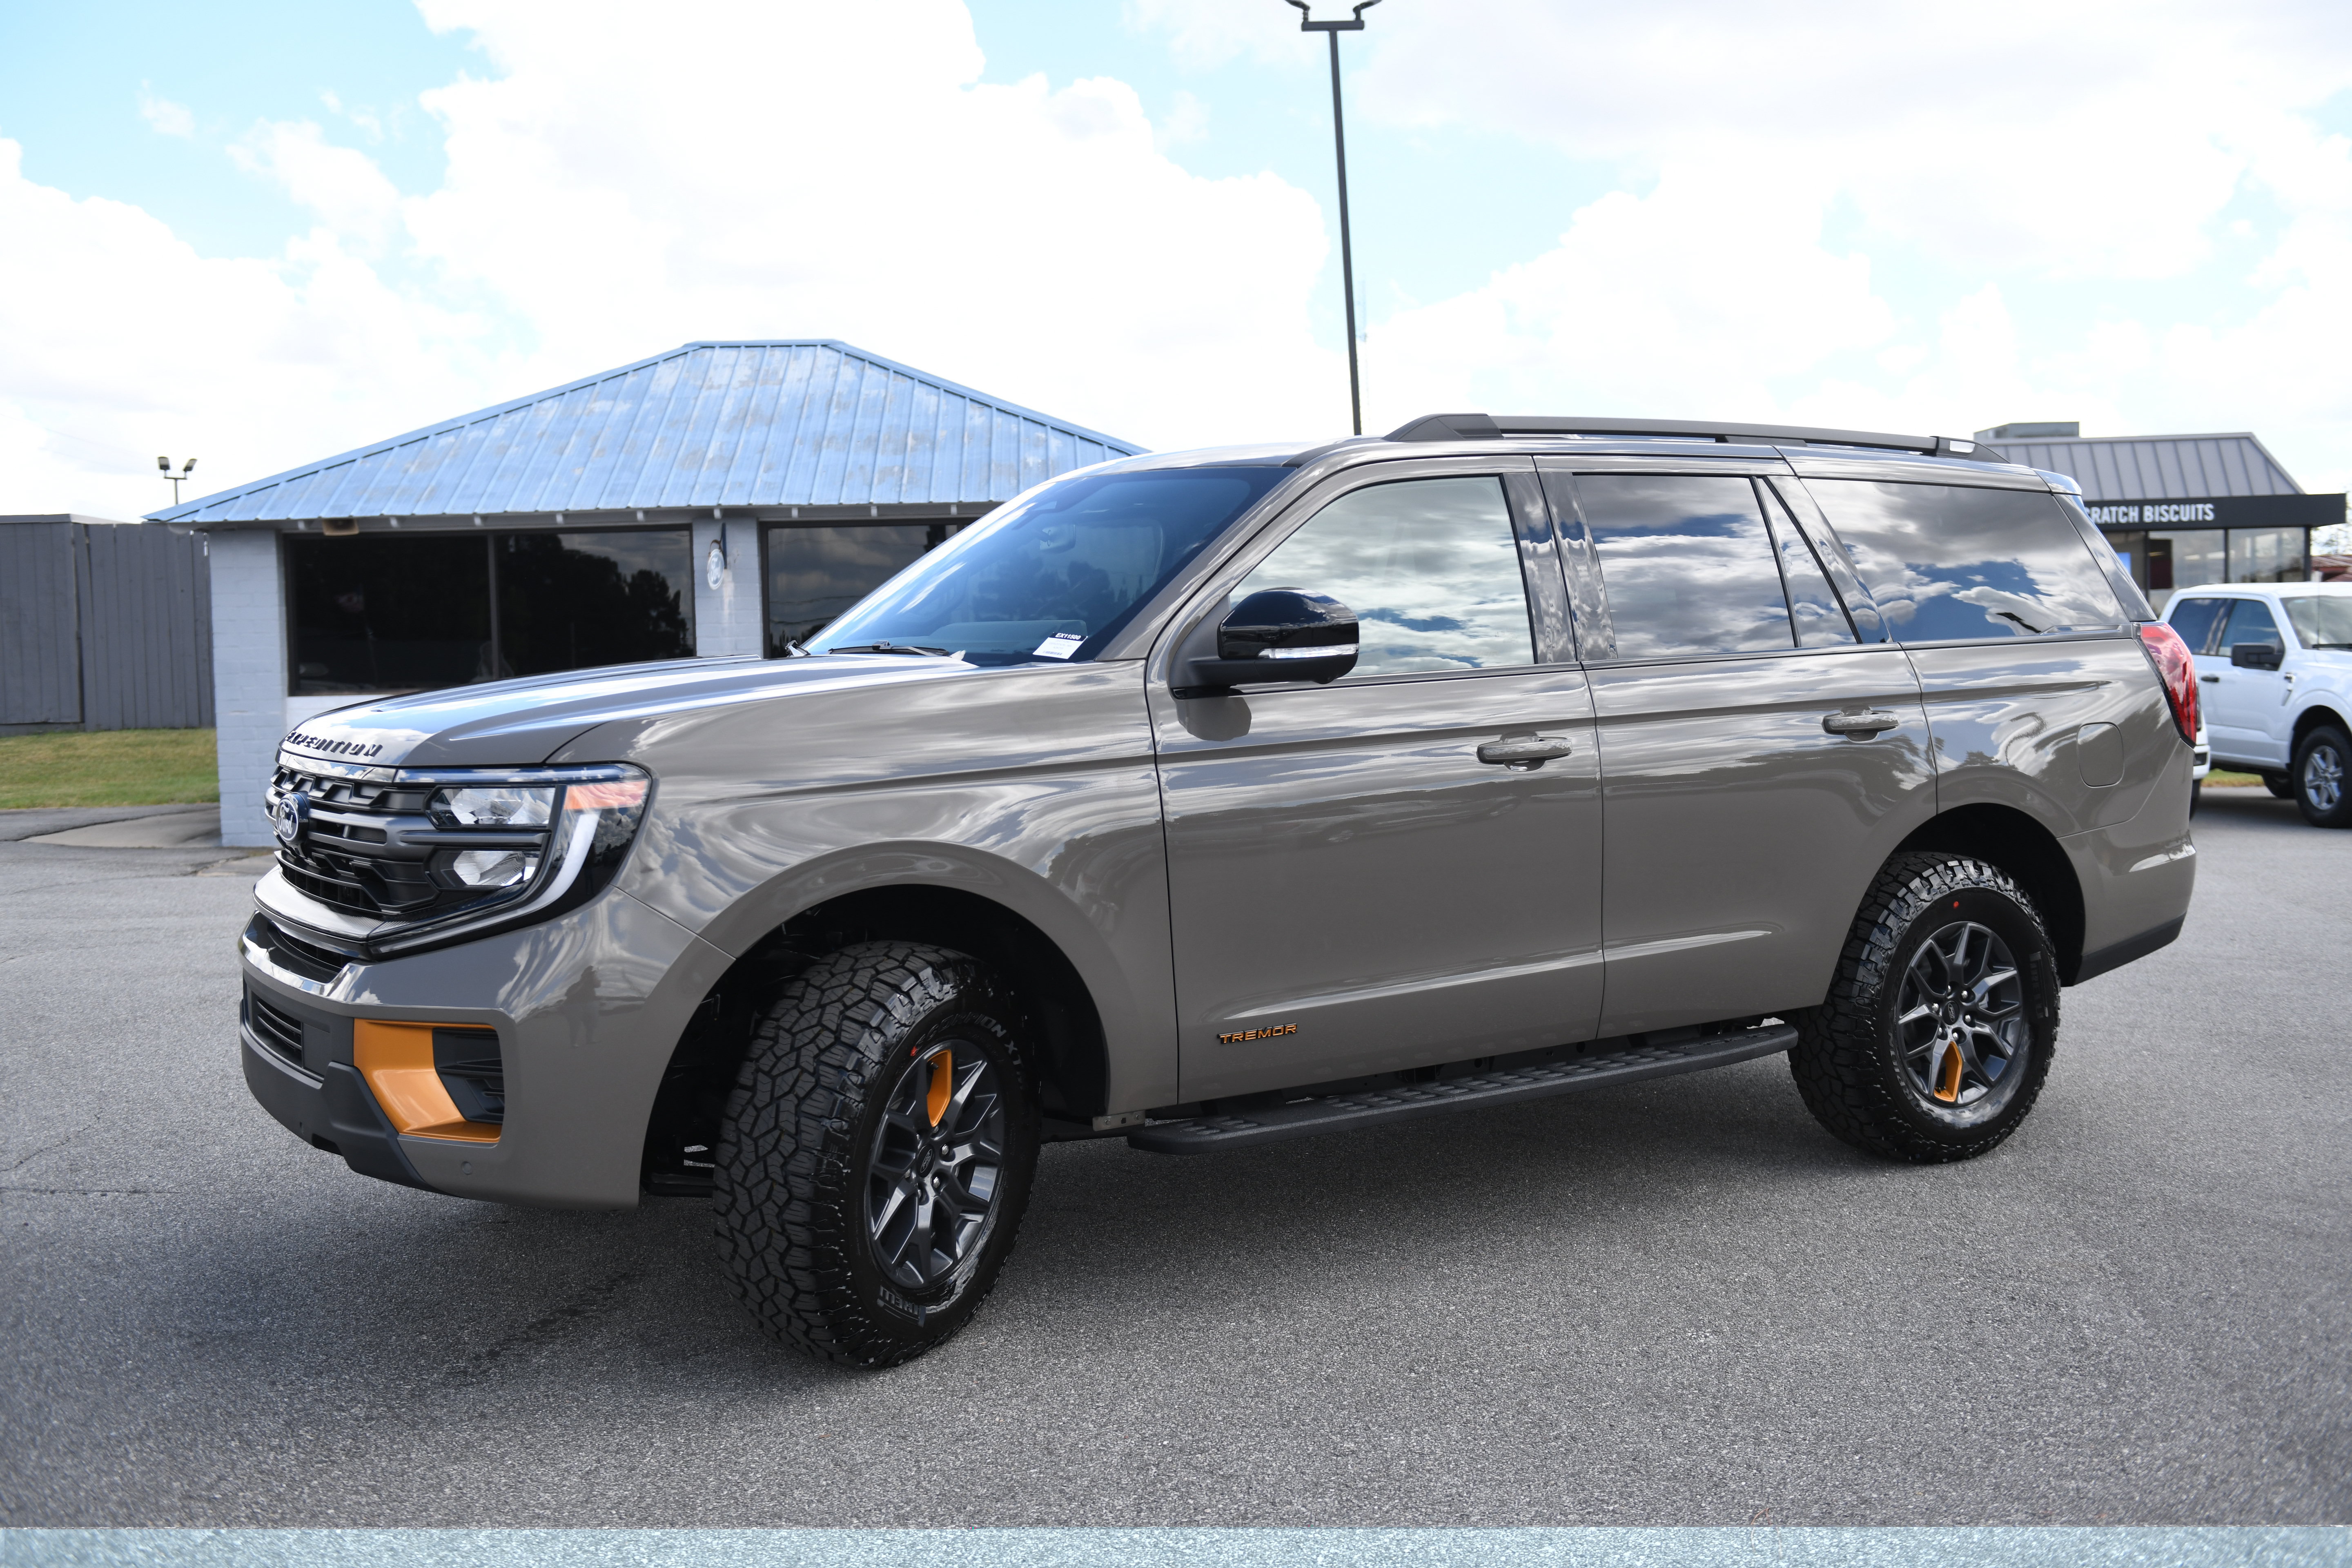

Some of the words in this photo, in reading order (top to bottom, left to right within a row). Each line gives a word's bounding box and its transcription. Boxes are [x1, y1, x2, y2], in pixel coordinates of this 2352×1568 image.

[2143, 503, 2215, 523] BISCUITS
[285, 731, 383, 757] EXPEDITION
[278, 803, 293, 835] Ford
[1217, 1023, 1298, 1044] TREMOR
